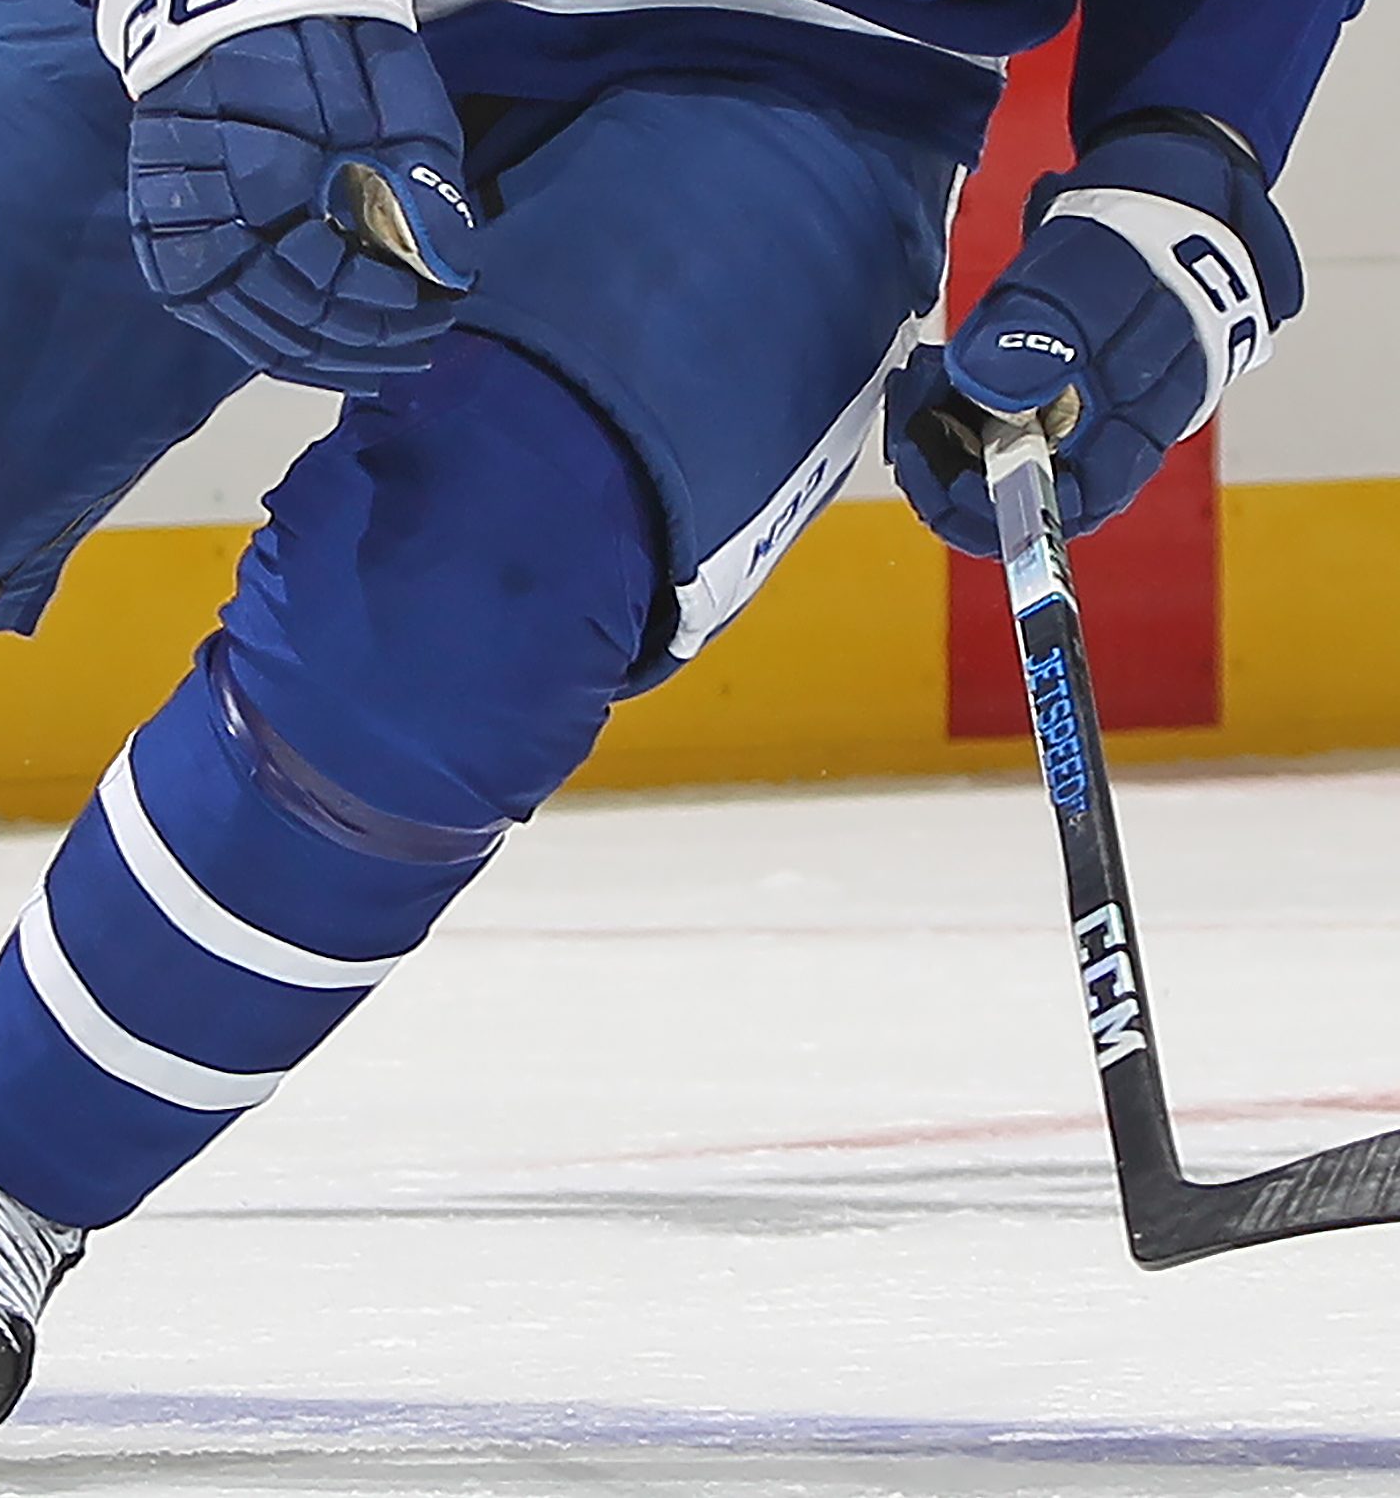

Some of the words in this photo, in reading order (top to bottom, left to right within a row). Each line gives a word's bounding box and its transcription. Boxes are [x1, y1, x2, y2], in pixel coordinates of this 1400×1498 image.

[998, 331, 1075, 364] CCM
[1026, 647, 1089, 808] JETSPEED
[1075, 903, 1148, 1070] CCM
